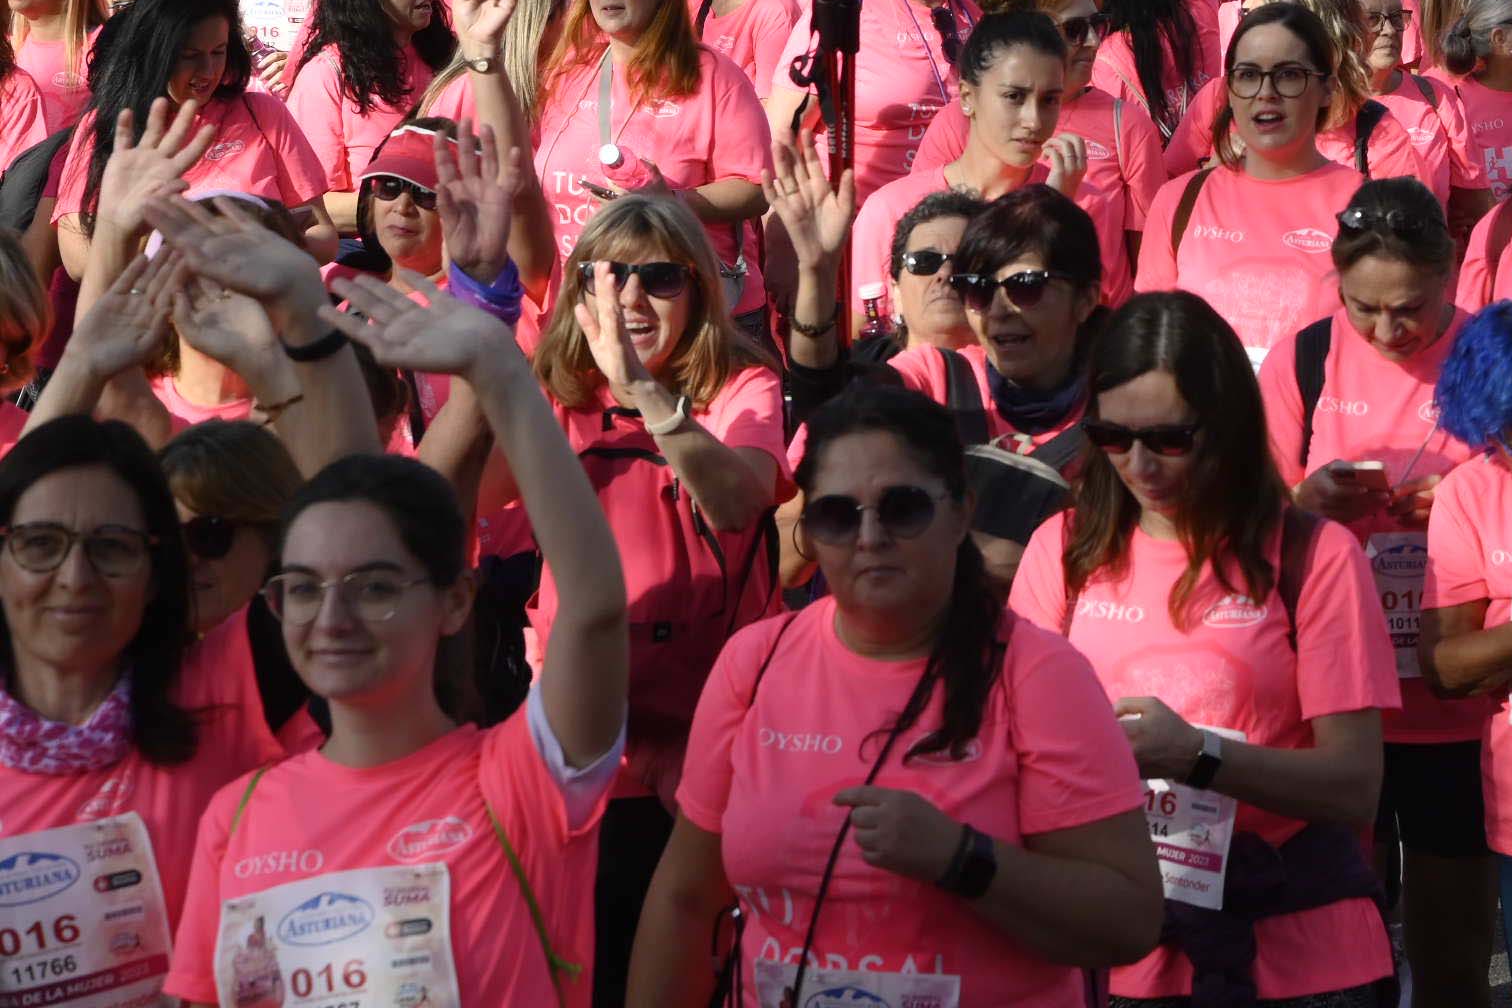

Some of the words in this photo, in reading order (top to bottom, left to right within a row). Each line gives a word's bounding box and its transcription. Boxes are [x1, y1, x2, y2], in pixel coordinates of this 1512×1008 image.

[553, 171, 587, 195] TU
[759, 728, 843, 754] OYSHO
[1146, 790, 1176, 816] 16
[234, 850, 324, 879] OYSHO
[1157, 847, 1185, 860] MUJER
[1164, 873, 1210, 893] Santander
[0, 914, 80, 956] 016
[288, 913, 367, 937] ASTURIANA
[12, 955, 78, 985] 11766
[291, 959, 367, 998] 016
[22, 990, 43, 1005] DE
[45, 987, 64, 1002] LA
